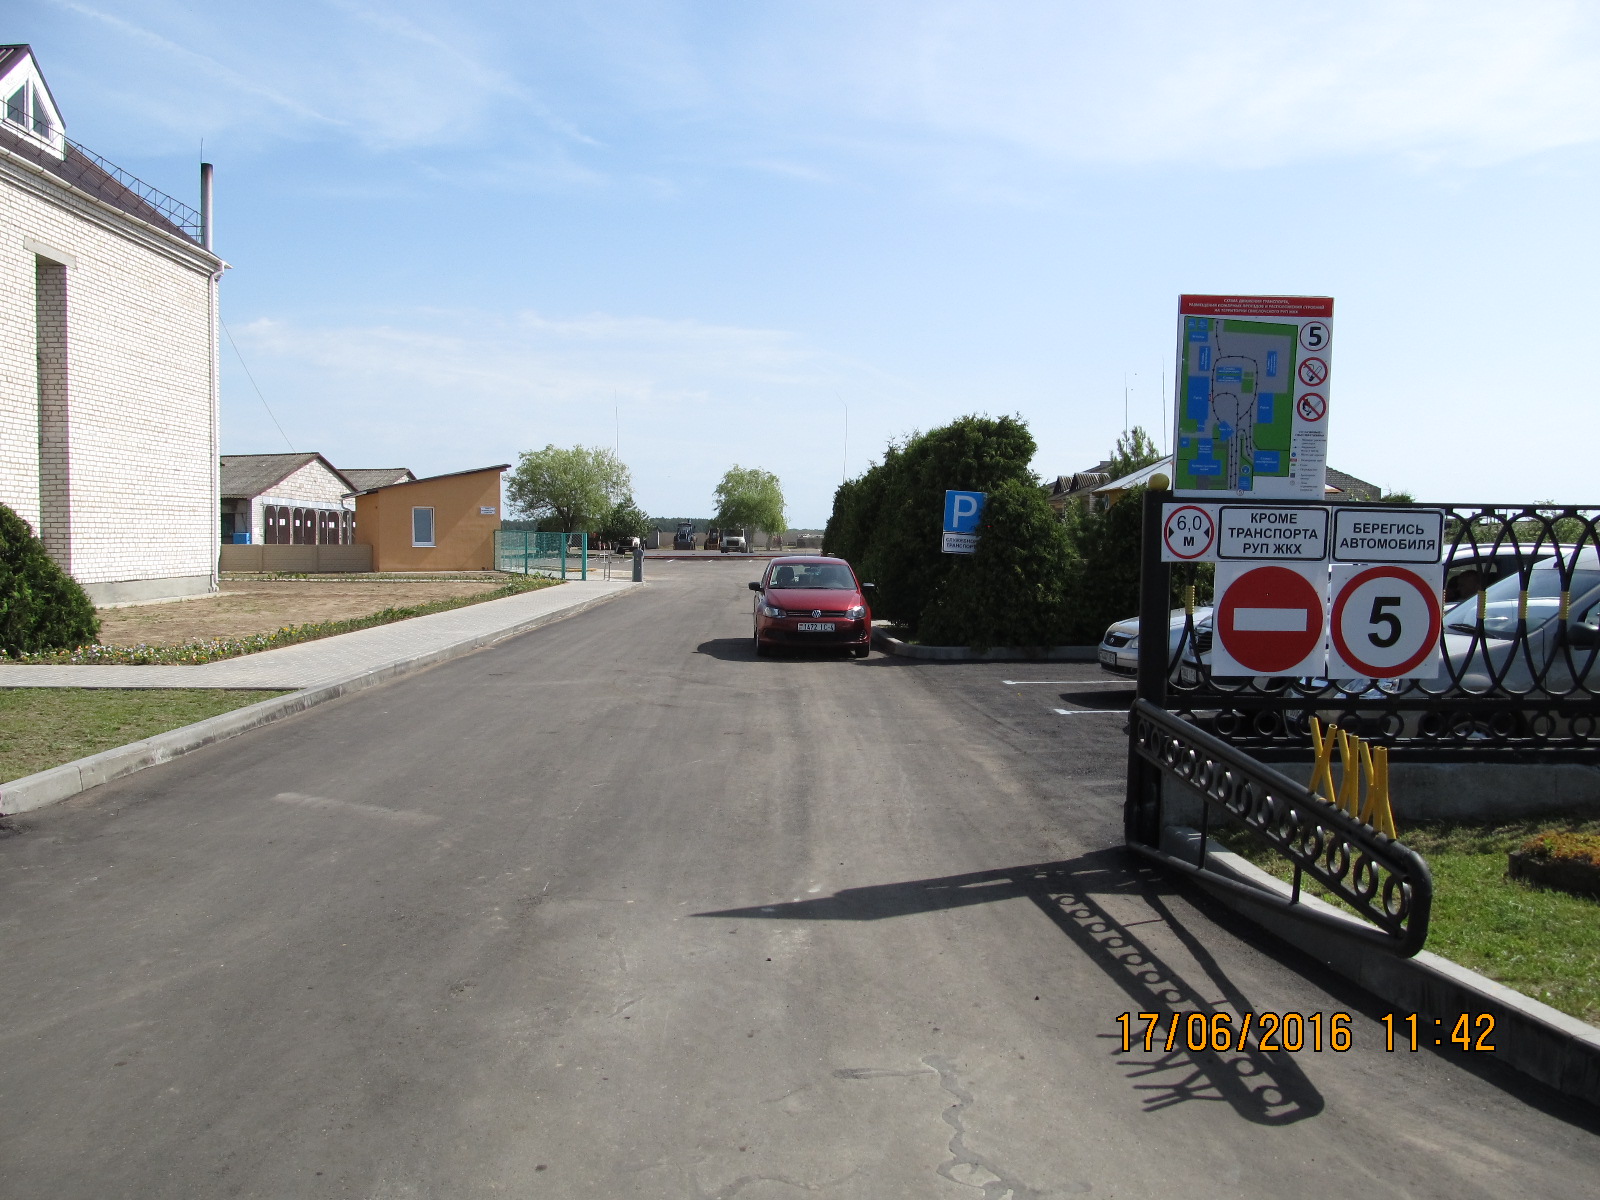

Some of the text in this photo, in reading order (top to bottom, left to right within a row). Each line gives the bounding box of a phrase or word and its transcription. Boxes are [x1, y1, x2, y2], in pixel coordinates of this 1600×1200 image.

[1309, 326, 1322, 346] 5
[953, 495, 977, 528] P
[1250, 513, 1298, 524] КРОМЕ
[1177, 515, 1202, 532] 6,0
[1353, 522, 1425, 535] БЕРЕГИСЬ
[1228, 527, 1318, 540] ТРАНСПОРТА
[1243, 542, 1302, 555] РУП ЖКХ
[1340, 537, 1435, 551] АВТОМОБИЛЯ
[1367, 596, 1402, 648] 5
